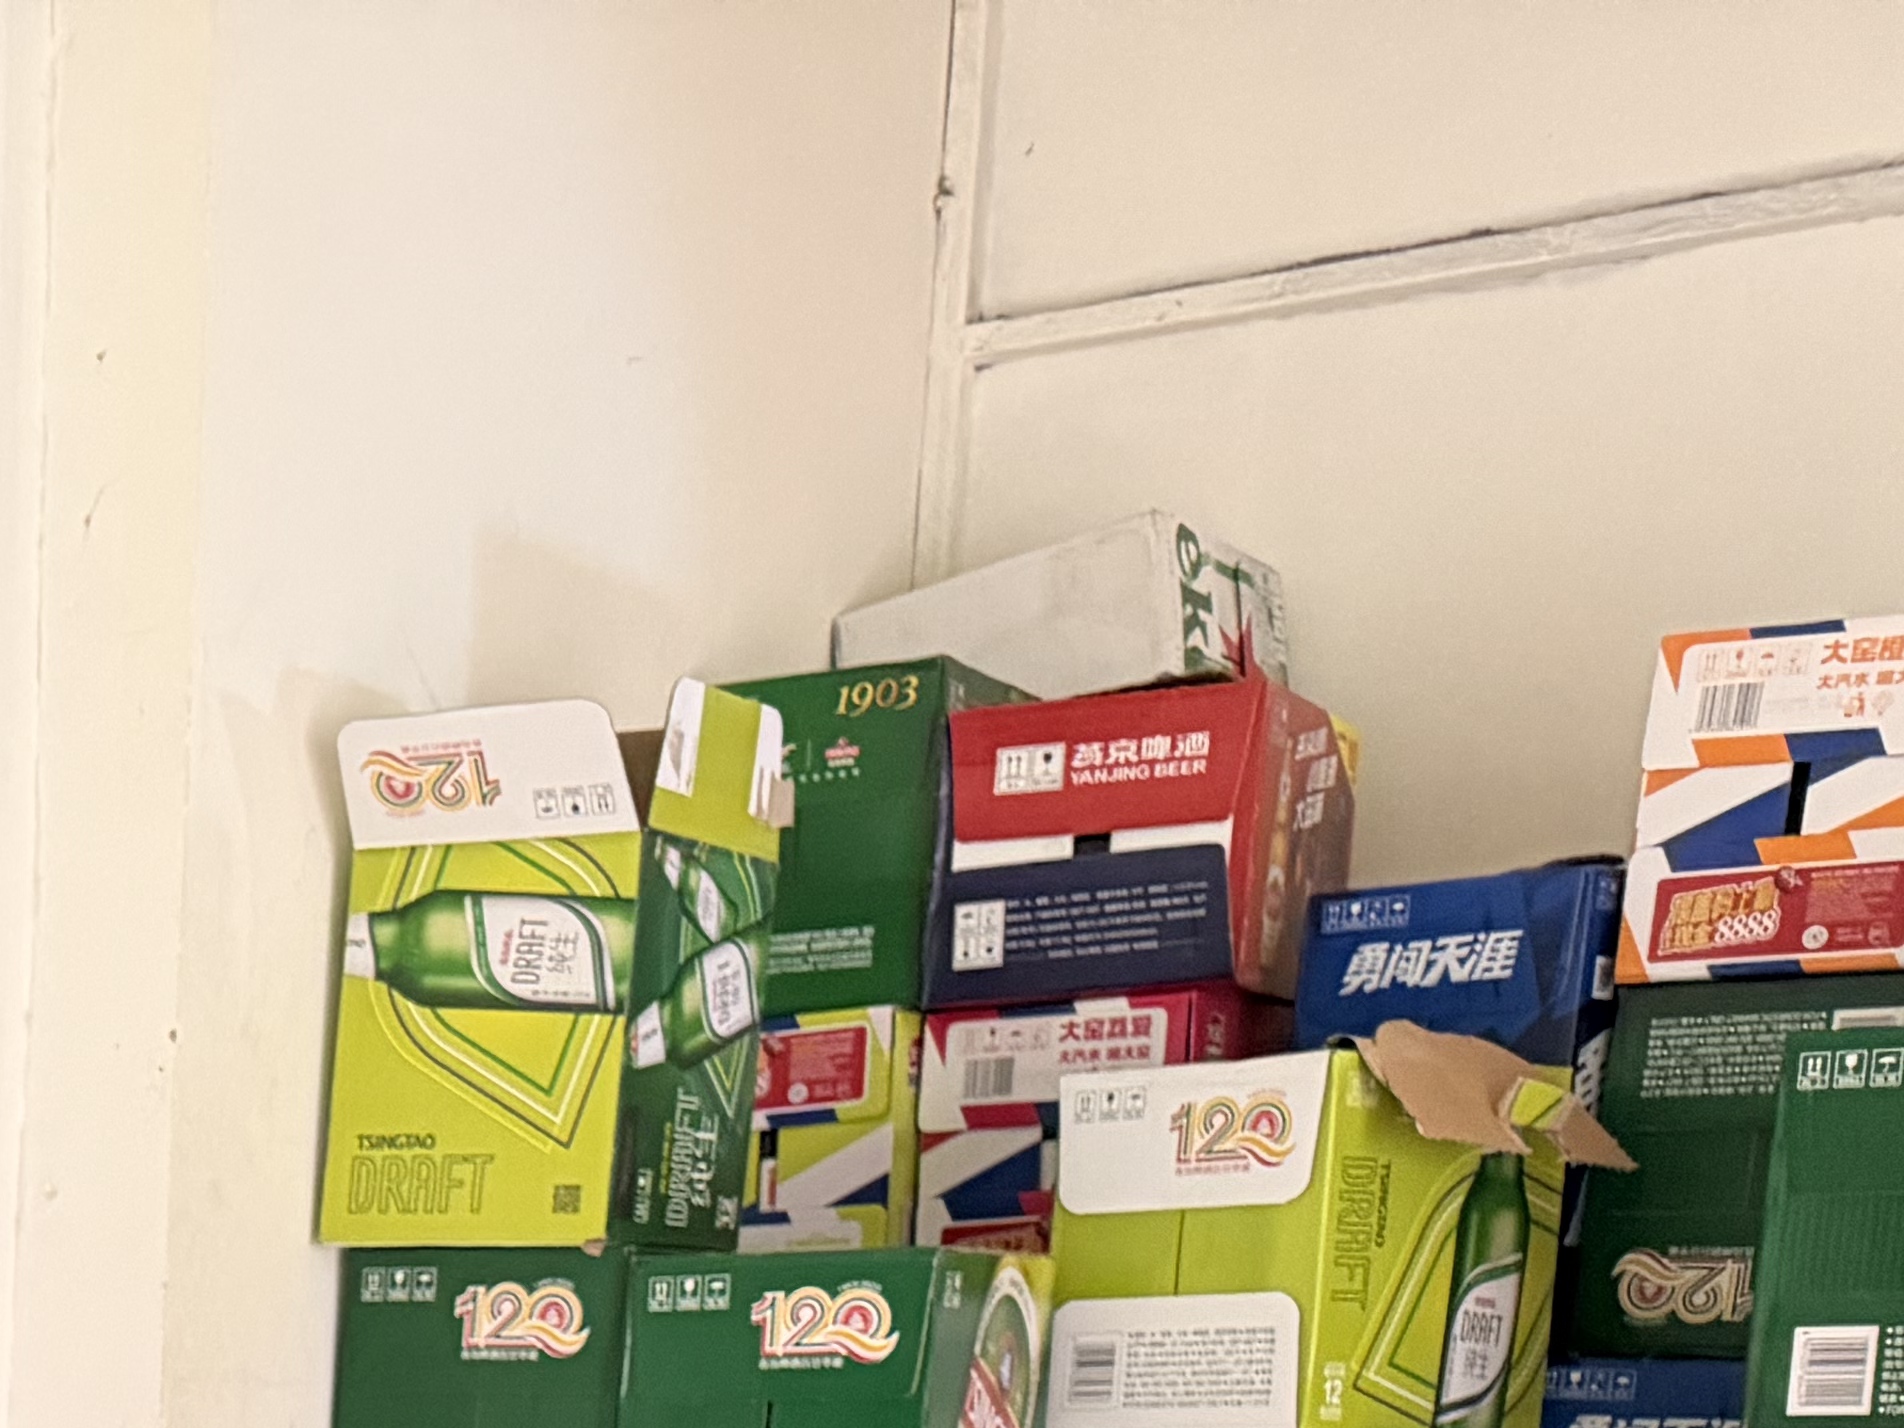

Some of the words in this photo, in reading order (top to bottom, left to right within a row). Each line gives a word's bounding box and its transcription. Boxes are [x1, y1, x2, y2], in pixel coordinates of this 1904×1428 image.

[835, 677, 920, 718] 1903
[1069, 762, 1150, 787] YANJING
[1154, 757, 1208, 780] BEER
[1070, 730, 1211, 768] 燕京啤酒
[510, 917, 549, 986] DRAFT
[1338, 928, 1525, 997] 勇闯天涯
[356, 1134, 437, 1150] TSINGTAO
[1169, 1094, 1297, 1169] 120
[346, 1153, 494, 1214] DRAFT
[1330, 1155, 1378, 1311] DRAFT
[454, 1280, 592, 1359] 120
[750, 1284, 901, 1364] 120
[1459, 1309, 1503, 1347] DRAFT
